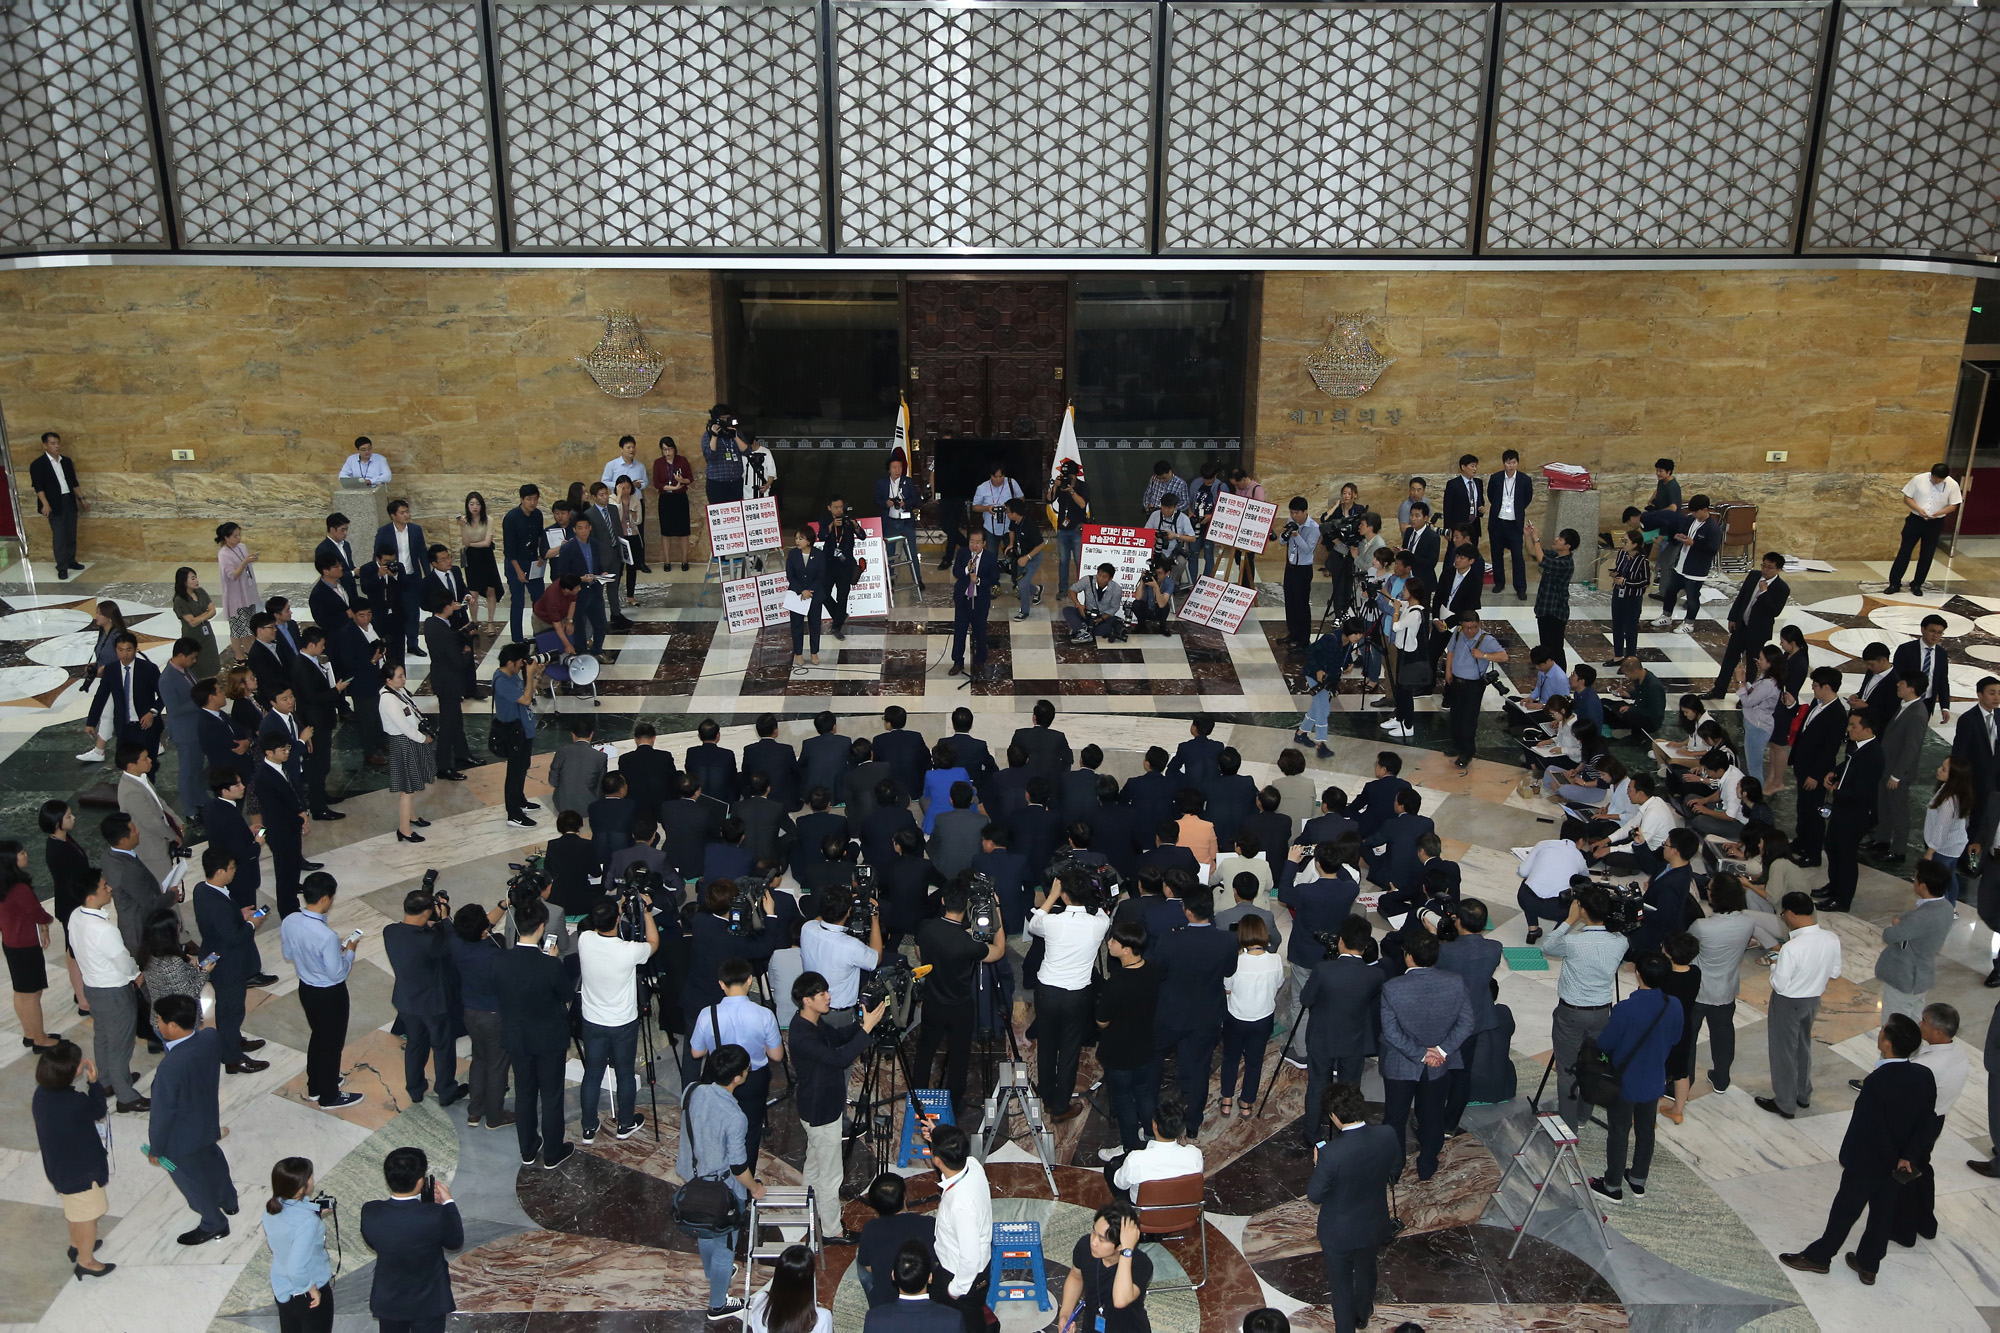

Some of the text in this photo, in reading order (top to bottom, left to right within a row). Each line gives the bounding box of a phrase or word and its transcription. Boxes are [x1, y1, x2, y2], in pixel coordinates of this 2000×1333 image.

[1288, 407, 1403, 426] 제1회의장
[723, 516, 740, 524] 규탄한다
[1100, 527, 1135, 537] 문재인 정권
[1090, 535, 1116, 544] 방송장악
[1132, 538, 1146, 546] 규탄
[726, 542, 744, 550] 강구하라
